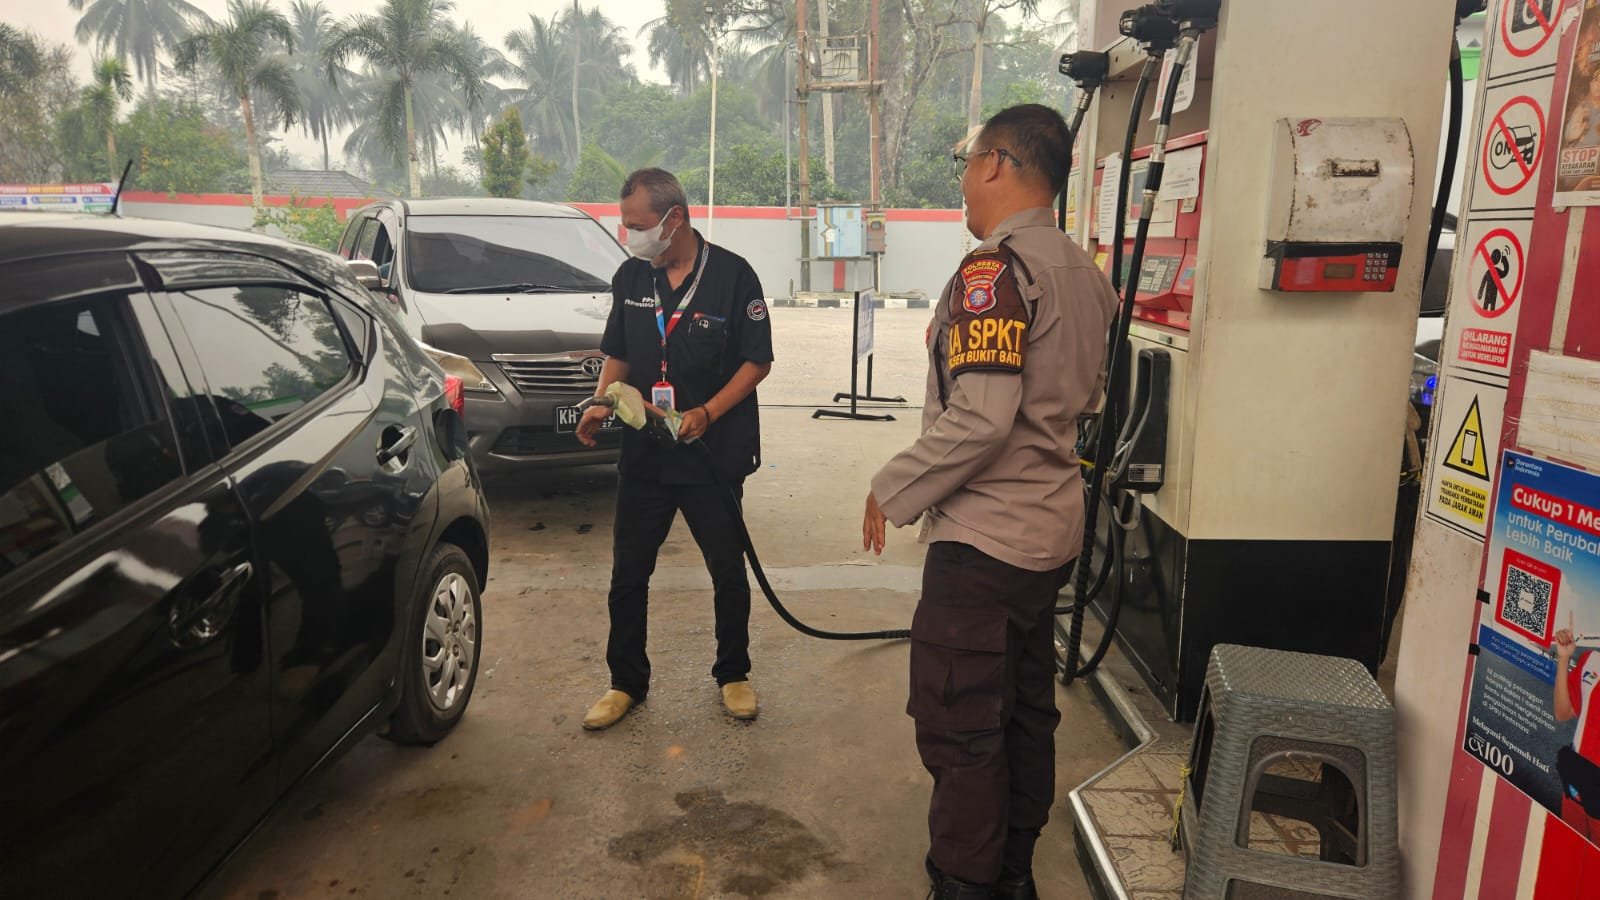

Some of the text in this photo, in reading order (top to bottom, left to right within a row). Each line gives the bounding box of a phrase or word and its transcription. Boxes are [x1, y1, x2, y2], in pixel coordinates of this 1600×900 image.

[1495, 141, 1511, 156] ON
[1563, 149, 1597, 163] STOP
[968, 318, 1026, 352] SPKT
[1463, 330, 1508, 347] DILARANG
[966, 349, 997, 362] BUKIT
[999, 350, 1022, 367] BATU
[559, 408, 577, 425] KH
[1439, 494, 1483, 520] PADA JARAK AMAN
[1513, 487, 1563, 518] Cukup
[1567, 504, 1574, 521] 1
[1508, 511, 1543, 535] untuk
[1506, 525, 1573, 563] Lebih Baik
[1472, 715, 1501, 741] Melayani
[1501, 735, 1532, 762] Sepenuh
[1532, 756, 1549, 774] Hati
